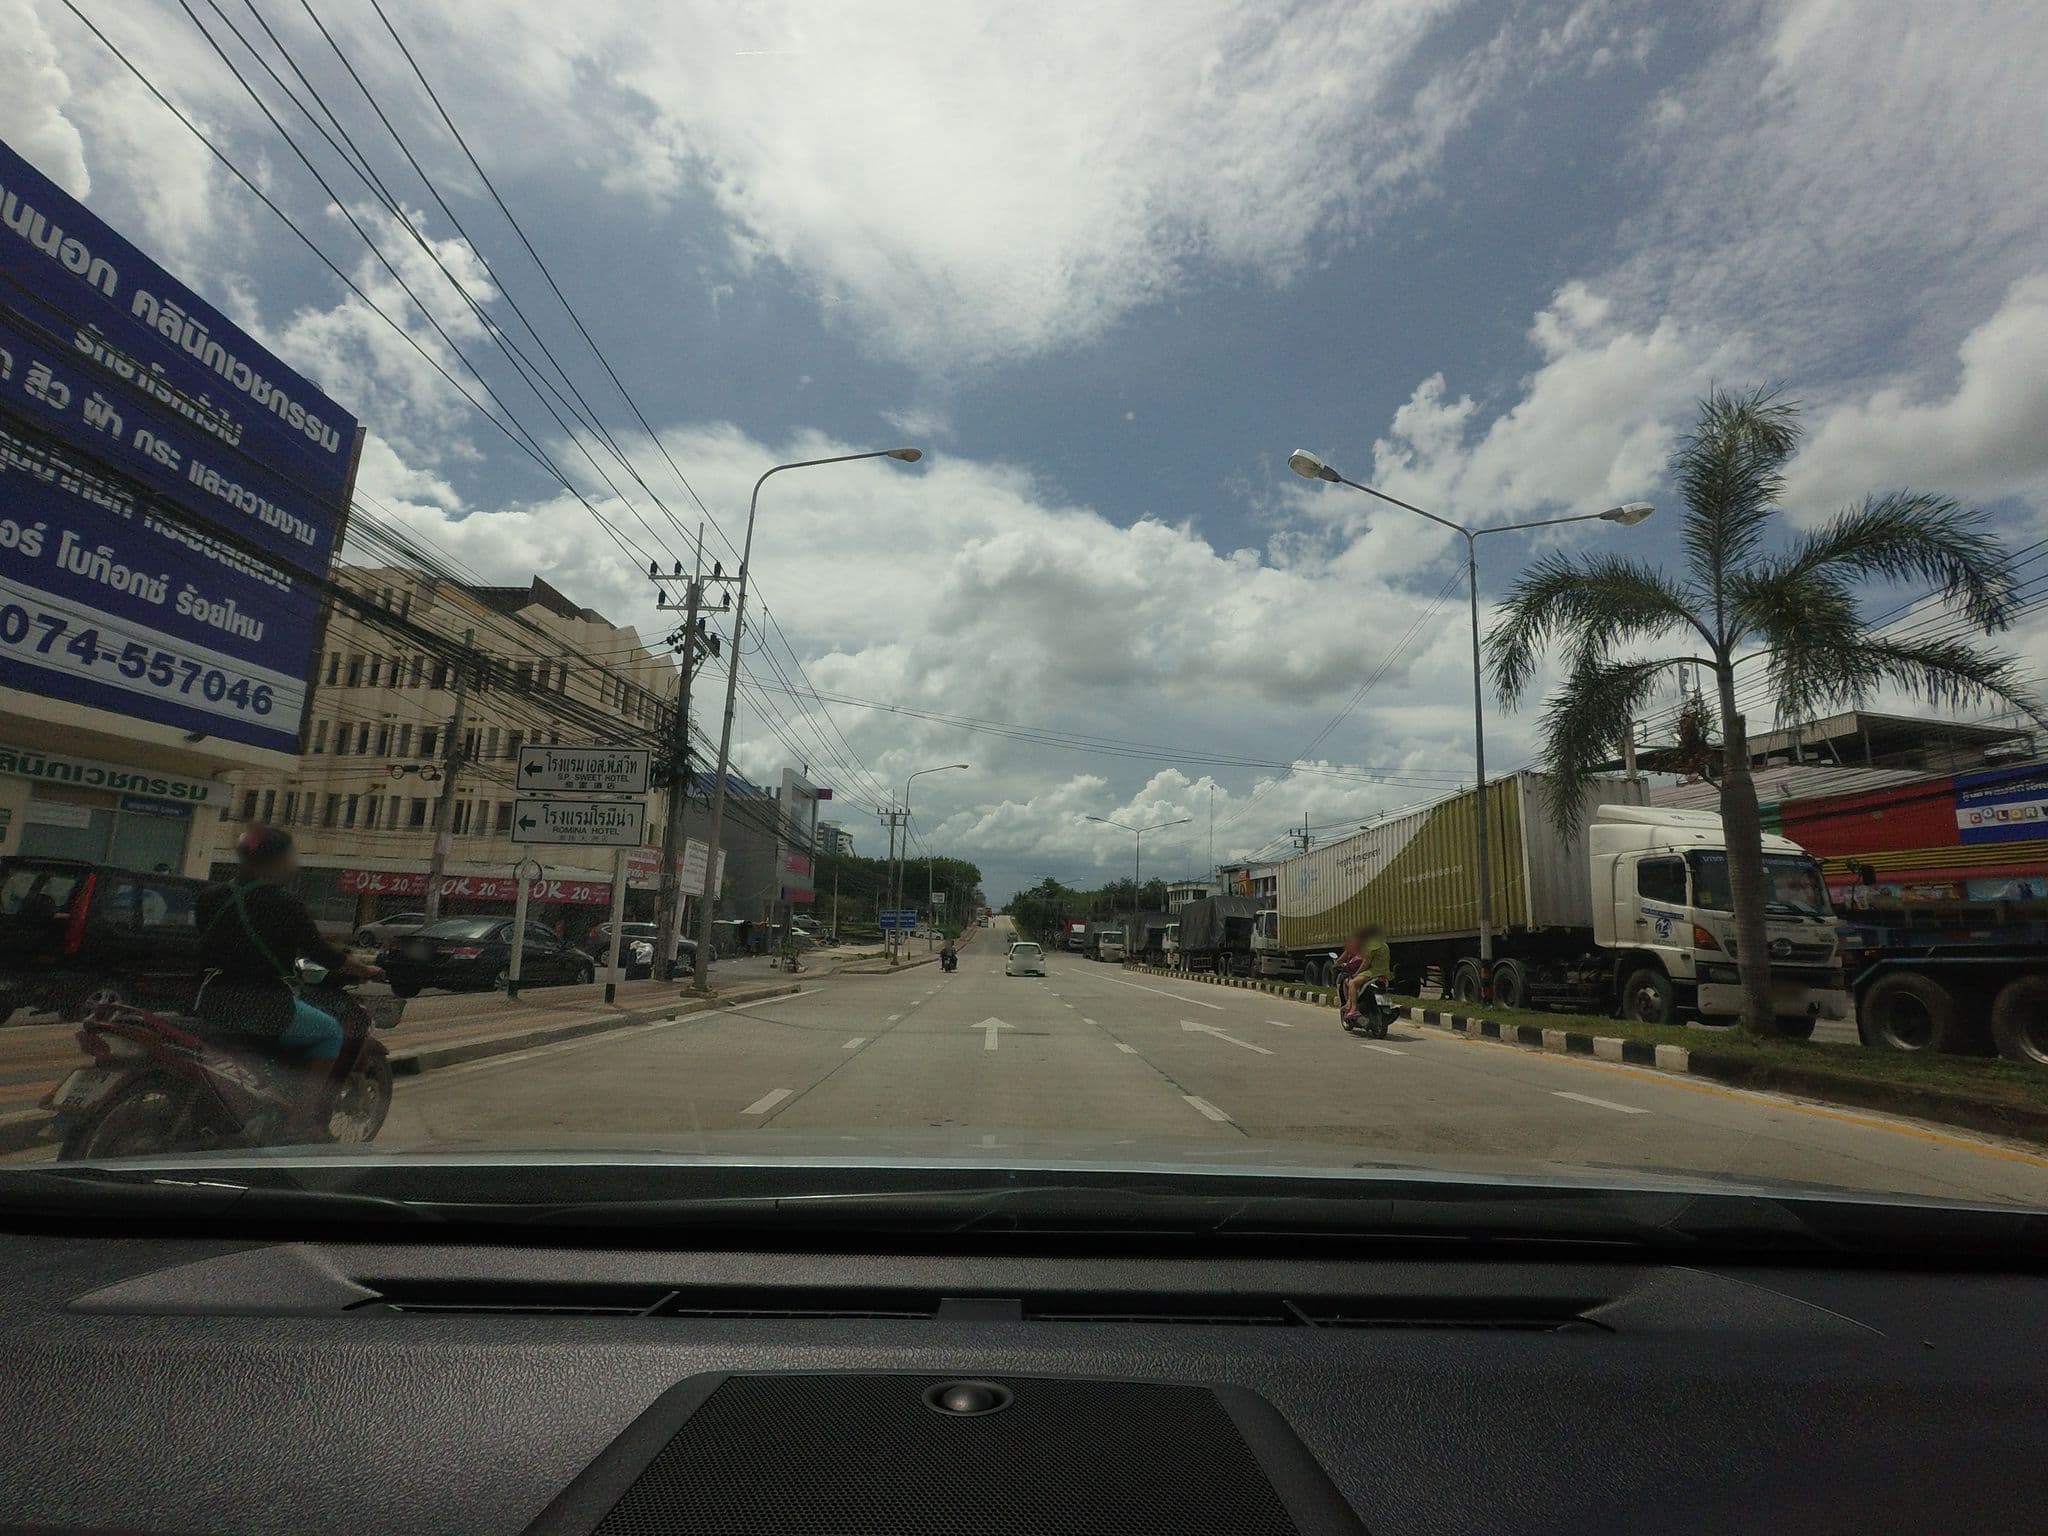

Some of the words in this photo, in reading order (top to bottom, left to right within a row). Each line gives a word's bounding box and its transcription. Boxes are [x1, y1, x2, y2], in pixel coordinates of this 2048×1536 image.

[0, 183, 118, 297] นนอก
[131, 289, 340, 453] คลินิกเวชกรรม
[133, 429, 181, 471] กระ
[176, 583, 264, 642] ร้อยไหม
[0, 604, 274, 715] 074-557046
[1970, 807, 2038, 824] COLOR
[591, 828, 620, 836] HOTEL
[440, 878, 474, 896] OK
[533, 880, 566, 899] OK
